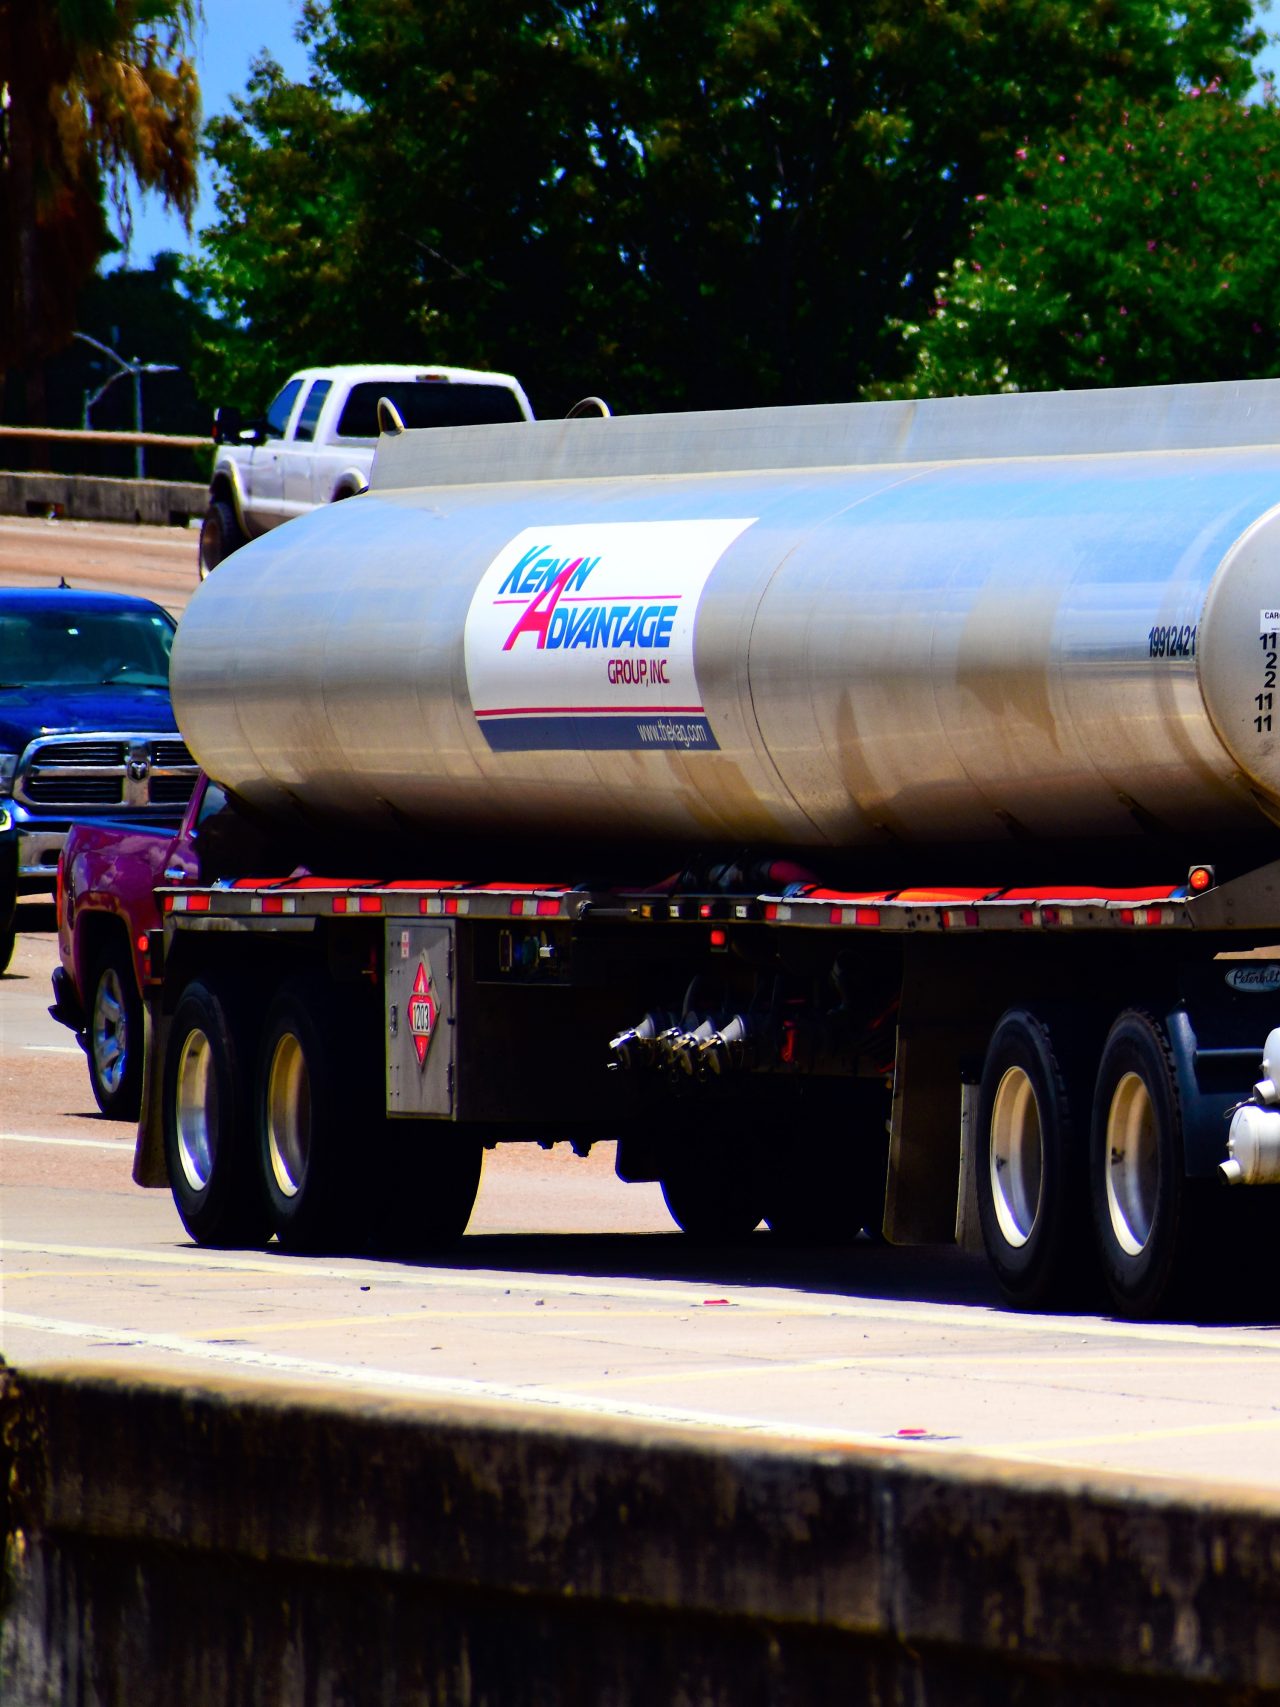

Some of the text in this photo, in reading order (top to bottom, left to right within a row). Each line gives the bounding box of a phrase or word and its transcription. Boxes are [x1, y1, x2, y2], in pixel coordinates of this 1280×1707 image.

[498, 545, 601, 594] KENAN
[502, 558, 678, 650] ADVANTAGE
[1148, 625, 1197, 658] 19912421
[1260, 632, 1277, 650] 11
[607, 659, 648, 687] GROUP,
[1266, 652, 1277, 669] 2
[1264, 671, 1276, 688] 2
[1255, 693, 1272, 710] 11
[637, 719, 708, 748] www.thekag.com
[1254, 715, 1271, 732] 11
[413, 1004, 428, 1030] 1203
